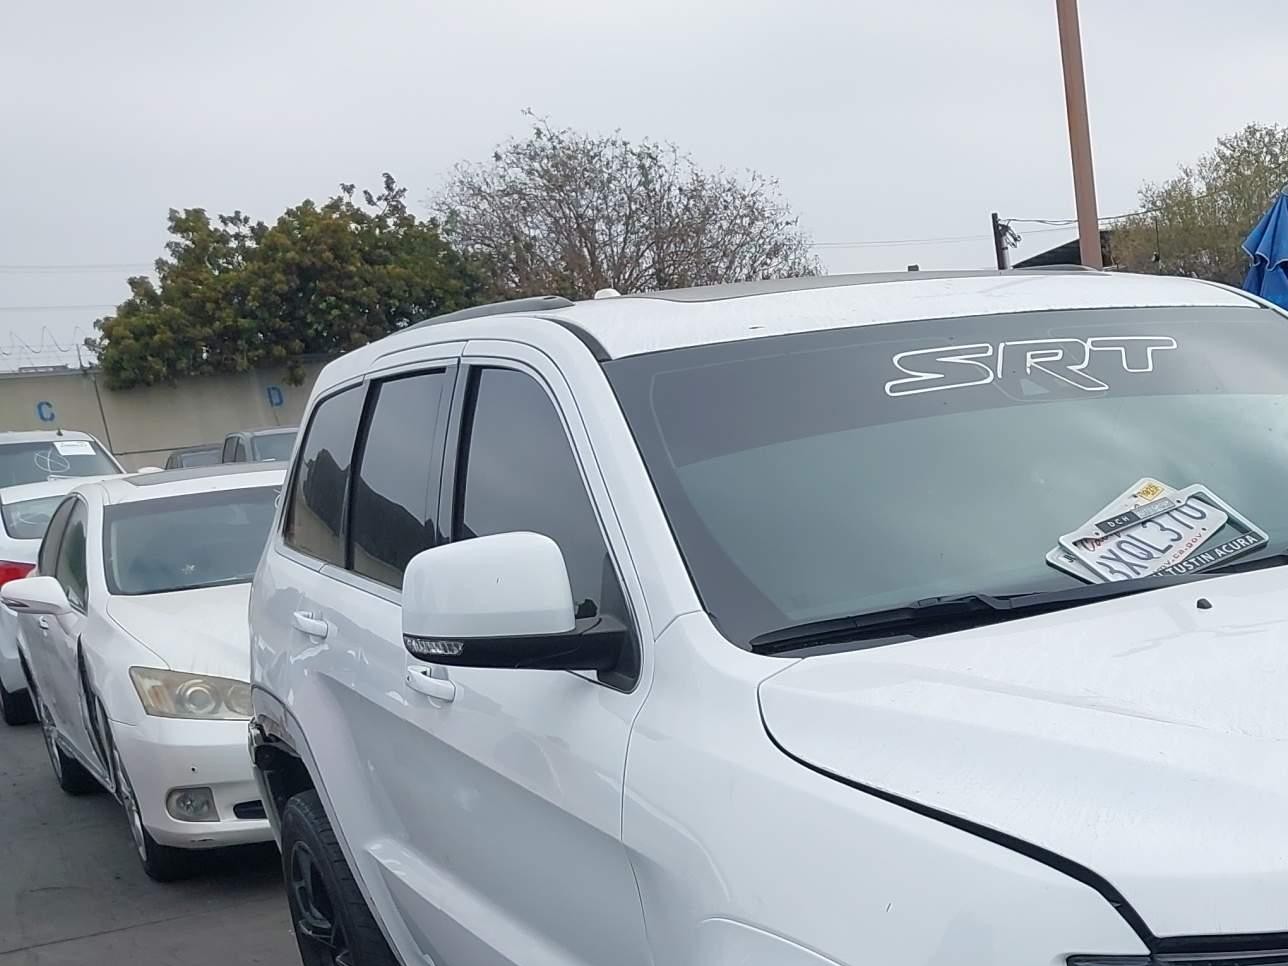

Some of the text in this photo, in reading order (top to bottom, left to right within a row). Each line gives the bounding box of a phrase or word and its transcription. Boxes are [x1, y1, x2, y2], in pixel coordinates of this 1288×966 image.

[884, 336, 1178, 397] SRT
[267, 385, 284, 407] D
[36, 400, 55, 422] C
[1107, 515, 1130, 528] DCH
[1166, 533, 1259, 576] TUSTIN ACURA
